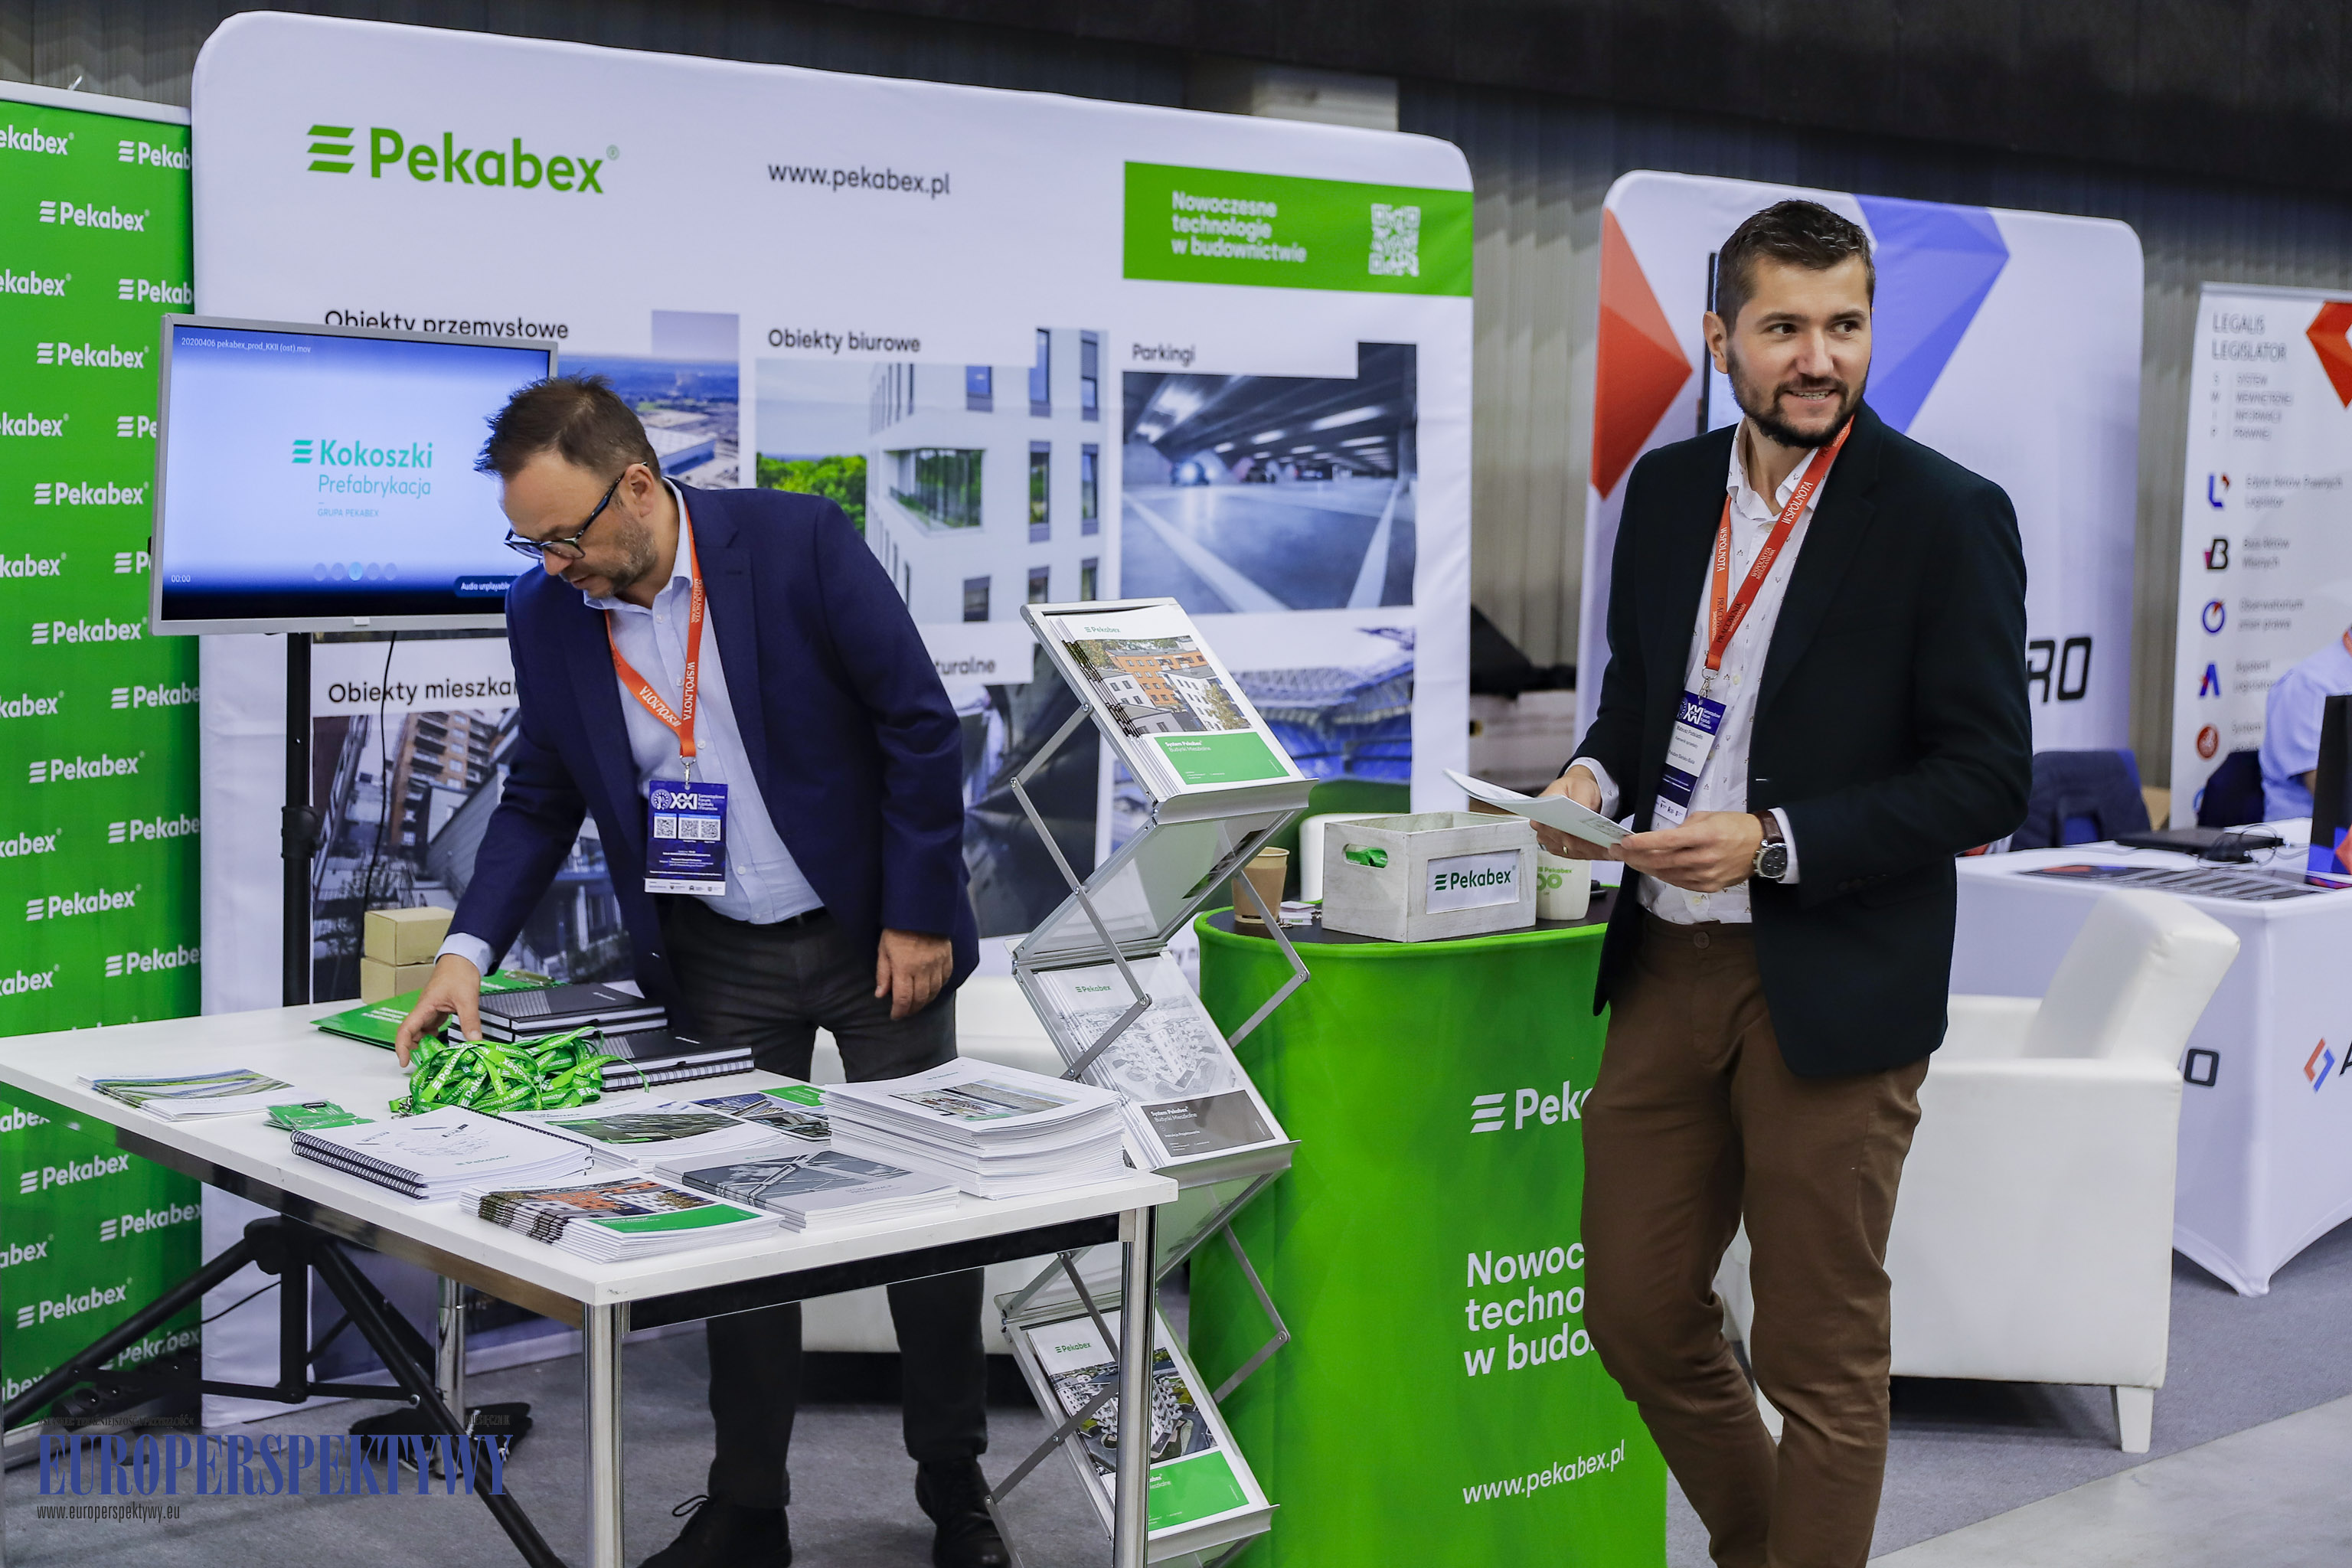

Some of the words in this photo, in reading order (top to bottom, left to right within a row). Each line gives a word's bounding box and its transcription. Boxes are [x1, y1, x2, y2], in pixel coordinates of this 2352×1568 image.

[0, 125, 67, 155] ekabex
[138, 142, 191, 169] Pekab
[370, 127, 603, 194] Pekabex
[768, 162, 951, 200] www.pekabex.pl
[60, 201, 144, 232] Pekabex
[1171, 191, 1277, 217] Nowoczesne
[1171, 214, 1272, 242] technologie
[1171, 238, 1188, 255] w
[1191, 237, 1308, 263] budownictwie
[0, 269, 65, 296] kabex
[137, 279, 194, 305] Pekab
[423, 317, 568, 338] przemysłowe
[768, 328, 842, 353] Obiekty
[848, 330, 922, 352] biurowe
[57, 342, 144, 369] Pekabex
[181, 337, 216, 348] 20200406
[1132, 343, 1197, 367] Parkingi
[2210, 338, 2287, 363] LEGISLATOR
[0, 412, 63, 436] kabex
[320, 439, 433, 469] Kokoszki
[55, 482, 143, 505] Pekabex
[318, 473, 431, 499] Prefabrykacja
[317, 508, 343, 517] GRUPA
[345, 508, 380, 518] PEKABEX
[1782, 481, 1814, 524] WSPÓLNOTA
[1717, 527, 1728, 572] WSPÓLNOTA
[0, 553, 60, 577] kabex
[171, 574, 191, 583] 00:00
[1716, 597, 1724, 628] PRACOW
[1716, 600, 1743, 643] PRACOWNIK
[53, 618, 142, 644] Pekabex
[1091, 626, 1121, 634] Pekabex
[133, 682, 200, 708] Pekabe
[328, 680, 418, 705] Obiekty
[425, 676, 519, 700] mieszka
[683, 662, 695, 720] WSPÓLNOTA
[0, 693, 58, 717] kabex
[51, 755, 139, 782] Pekabex
[130, 813, 200, 841] Pekabe
[1451, 861, 1511, 890] Pekabex
[47, 887, 136, 919] Pekabex
[126, 945, 200, 975] Pekabe
[1082, 985, 1112, 993] Pekabex
[42, 1154, 129, 1190] Pekabex
[1465, 1242, 1585, 1288] Nowoc
[39, 1285, 126, 1325] Pekabex
[1465, 1285, 1585, 1332] techno
[1062, 1342, 1092, 1354] Pekabex
[1464, 1345, 1495, 1377] w
[1462, 1439, 1625, 1504] www.pekabex.pl
